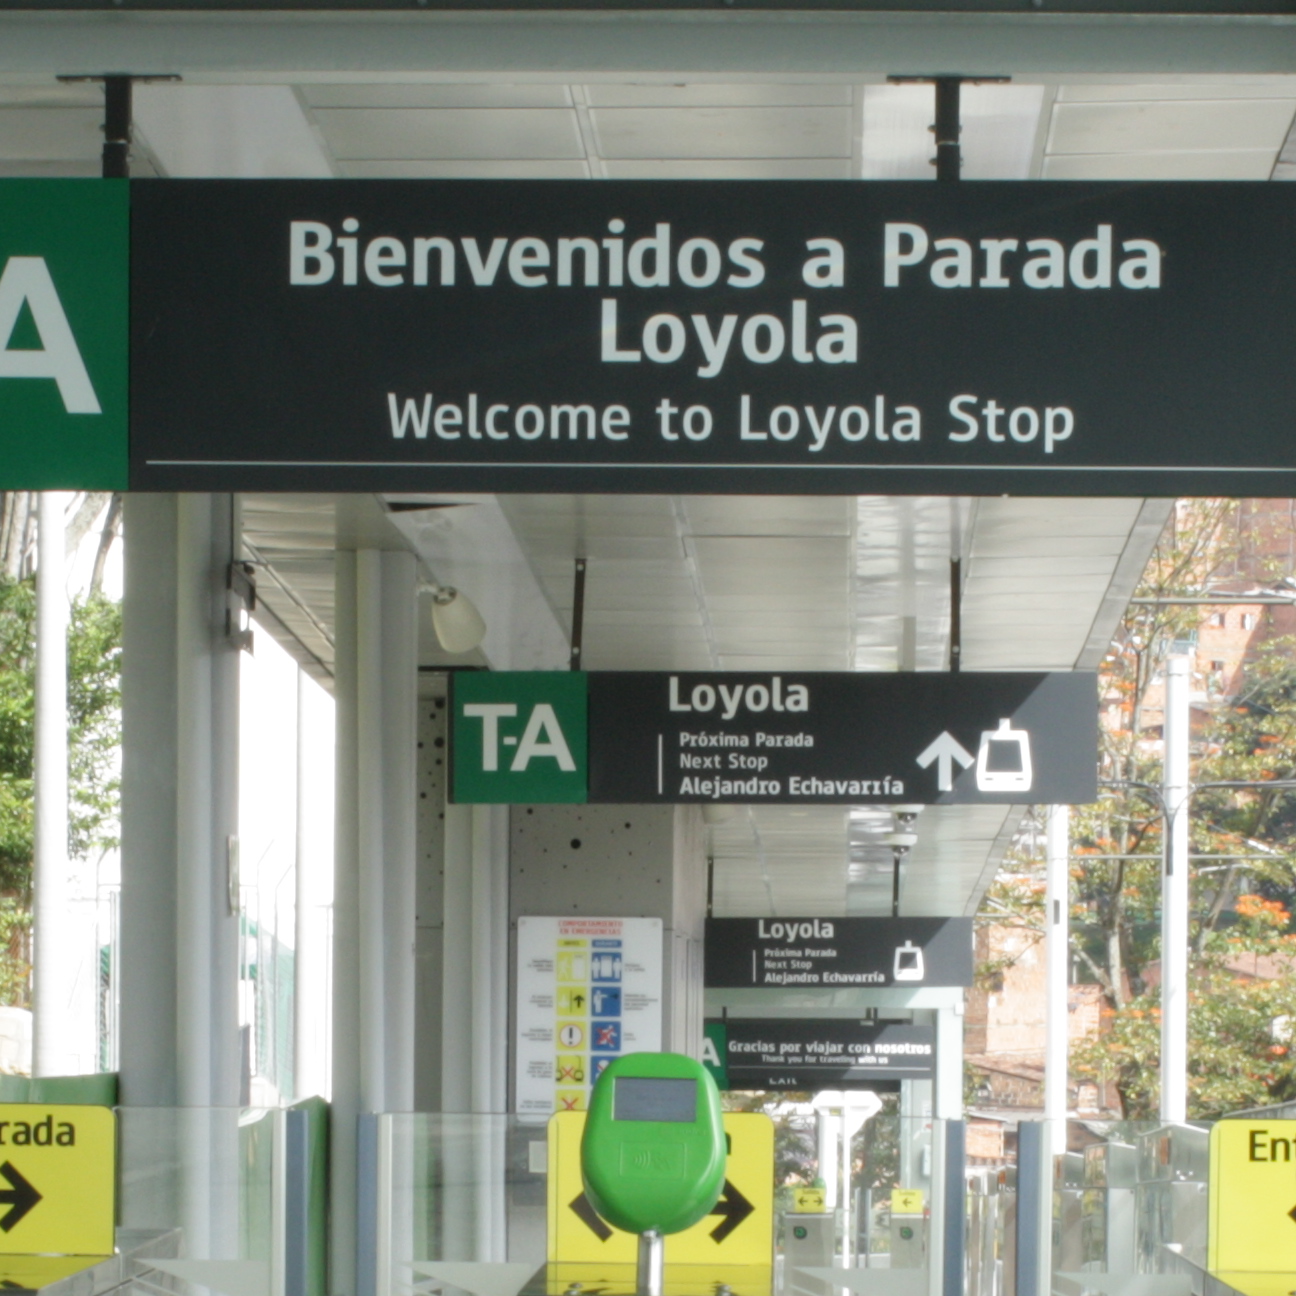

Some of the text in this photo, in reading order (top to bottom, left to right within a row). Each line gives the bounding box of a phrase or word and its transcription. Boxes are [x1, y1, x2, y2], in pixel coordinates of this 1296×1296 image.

[290, 218, 1163, 290] Bienvenidos a Parada
[602, 298, 858, 378] Loyola
[388, 394, 1074, 453] Welcome to Loyola Stop
[669, 676, 809, 720] Loyola
[464, 704, 576, 771] T-A
[679, 731, 814, 748] Próxima Parada
[679, 752, 768, 772] Next Stop
[679, 774, 904, 798] Alejandro Echavarría
[758, 918, 834, 943] Loyola
[764, 948, 837, 958] Próxima Parada
[764, 959, 813, 971] Next Stop
[764, 971, 886, 985] Alejandro Echavarría
[728, 1040, 932, 1055] Gracias por viajar con nosotros
[761, 1054, 785, 1063] Thank
[788, 1056, 802, 1064] you
[804, 1055, 817, 1064] for
[819, 1055, 856, 1065] traveling
[858, 1055, 876, 1064] with
